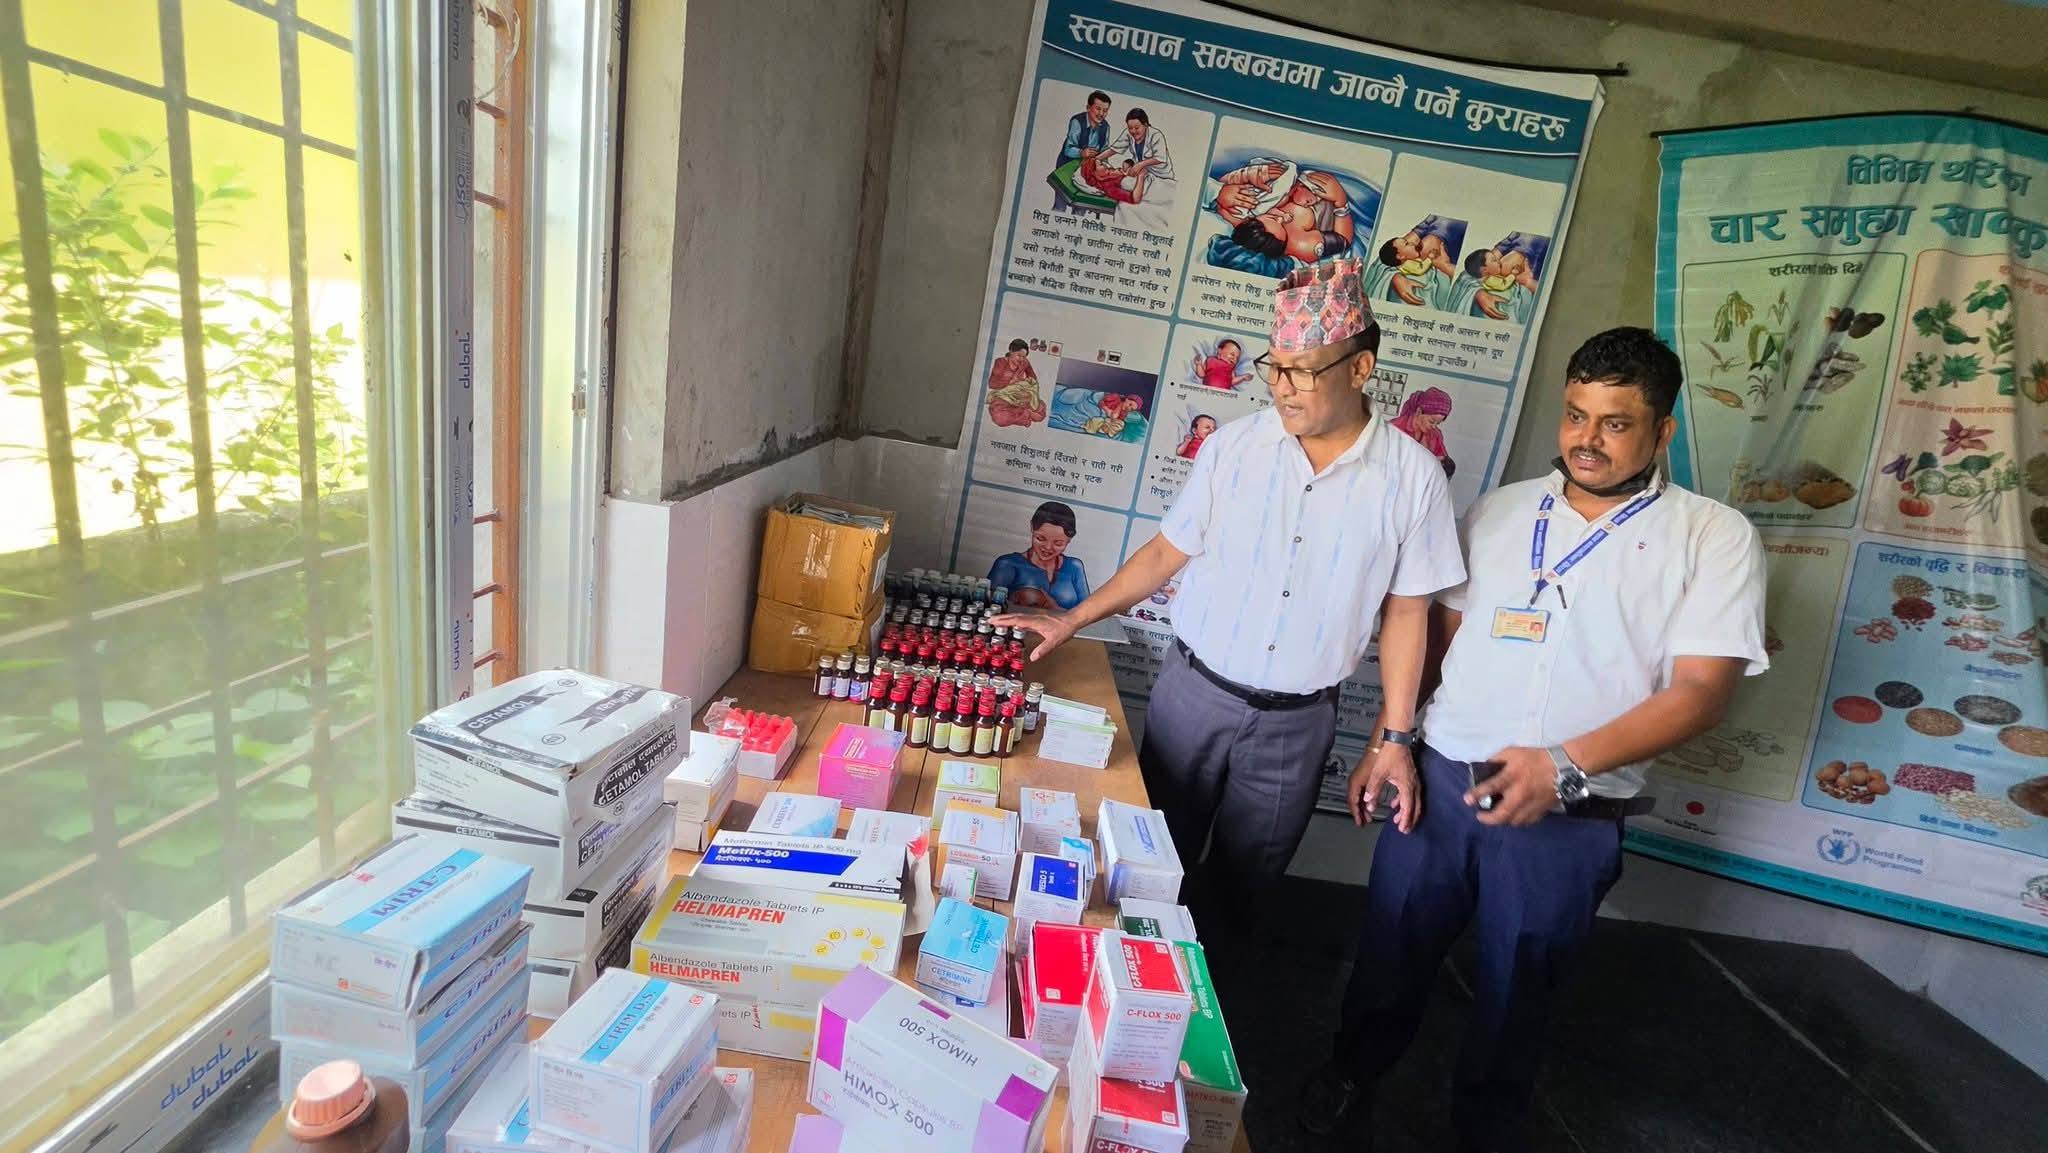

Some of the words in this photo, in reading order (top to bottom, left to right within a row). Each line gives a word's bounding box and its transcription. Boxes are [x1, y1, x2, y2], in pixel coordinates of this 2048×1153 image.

[1069, 14, 1185, 61] स्तनपान
[1192, 40, 1325, 91] सम्बन्धमा
[1329, 70, 1408, 108] जान्नै
[1414, 86, 1460, 119] पर्ने
[1709, 209, 1787, 244] चार
[1142, 230, 1174, 247] शिशुलाई
[1069, 250, 1100, 266] शिशुलाई
[1099, 287, 1113, 300] पनि
[1403, 315, 1436, 331] शिशुलाई
[1020, 444, 1051, 460] शिशुलाई
[467, 698, 535, 730] CETAMOL
[466, 755, 505, 778] CETAMOL
[644, 740, 678, 772] TABLETS
[455, 825, 498, 840] CETAMOL
[717, 846, 790, 859] Metfix-500
[672, 900, 786, 924] HELMAPREN
[680, 889, 762, 908] Albendazole
[765, 899, 809, 914] Tablets
[812, 906, 825, 915] IP
[649, 961, 740, 982] HELMAPREN
[650, 952, 718, 970] Albendazole
[720, 960, 759, 974] Tablets
[761, 965, 774, 974] IP
[740, 1011, 751, 1020] IP
[1127, 1008, 1162, 1019] C-FLOX
[1164, 1011, 1182, 1021] 500
[898, 1016, 928, 1038] 500
[927, 1030, 978, 1068] HIMOX
[161, 1043, 233, 1110] dubal
[192, 1046, 259, 1110] dubal
[844, 1070, 900, 1114] HIMOX
[904, 1111, 935, 1136] 500
